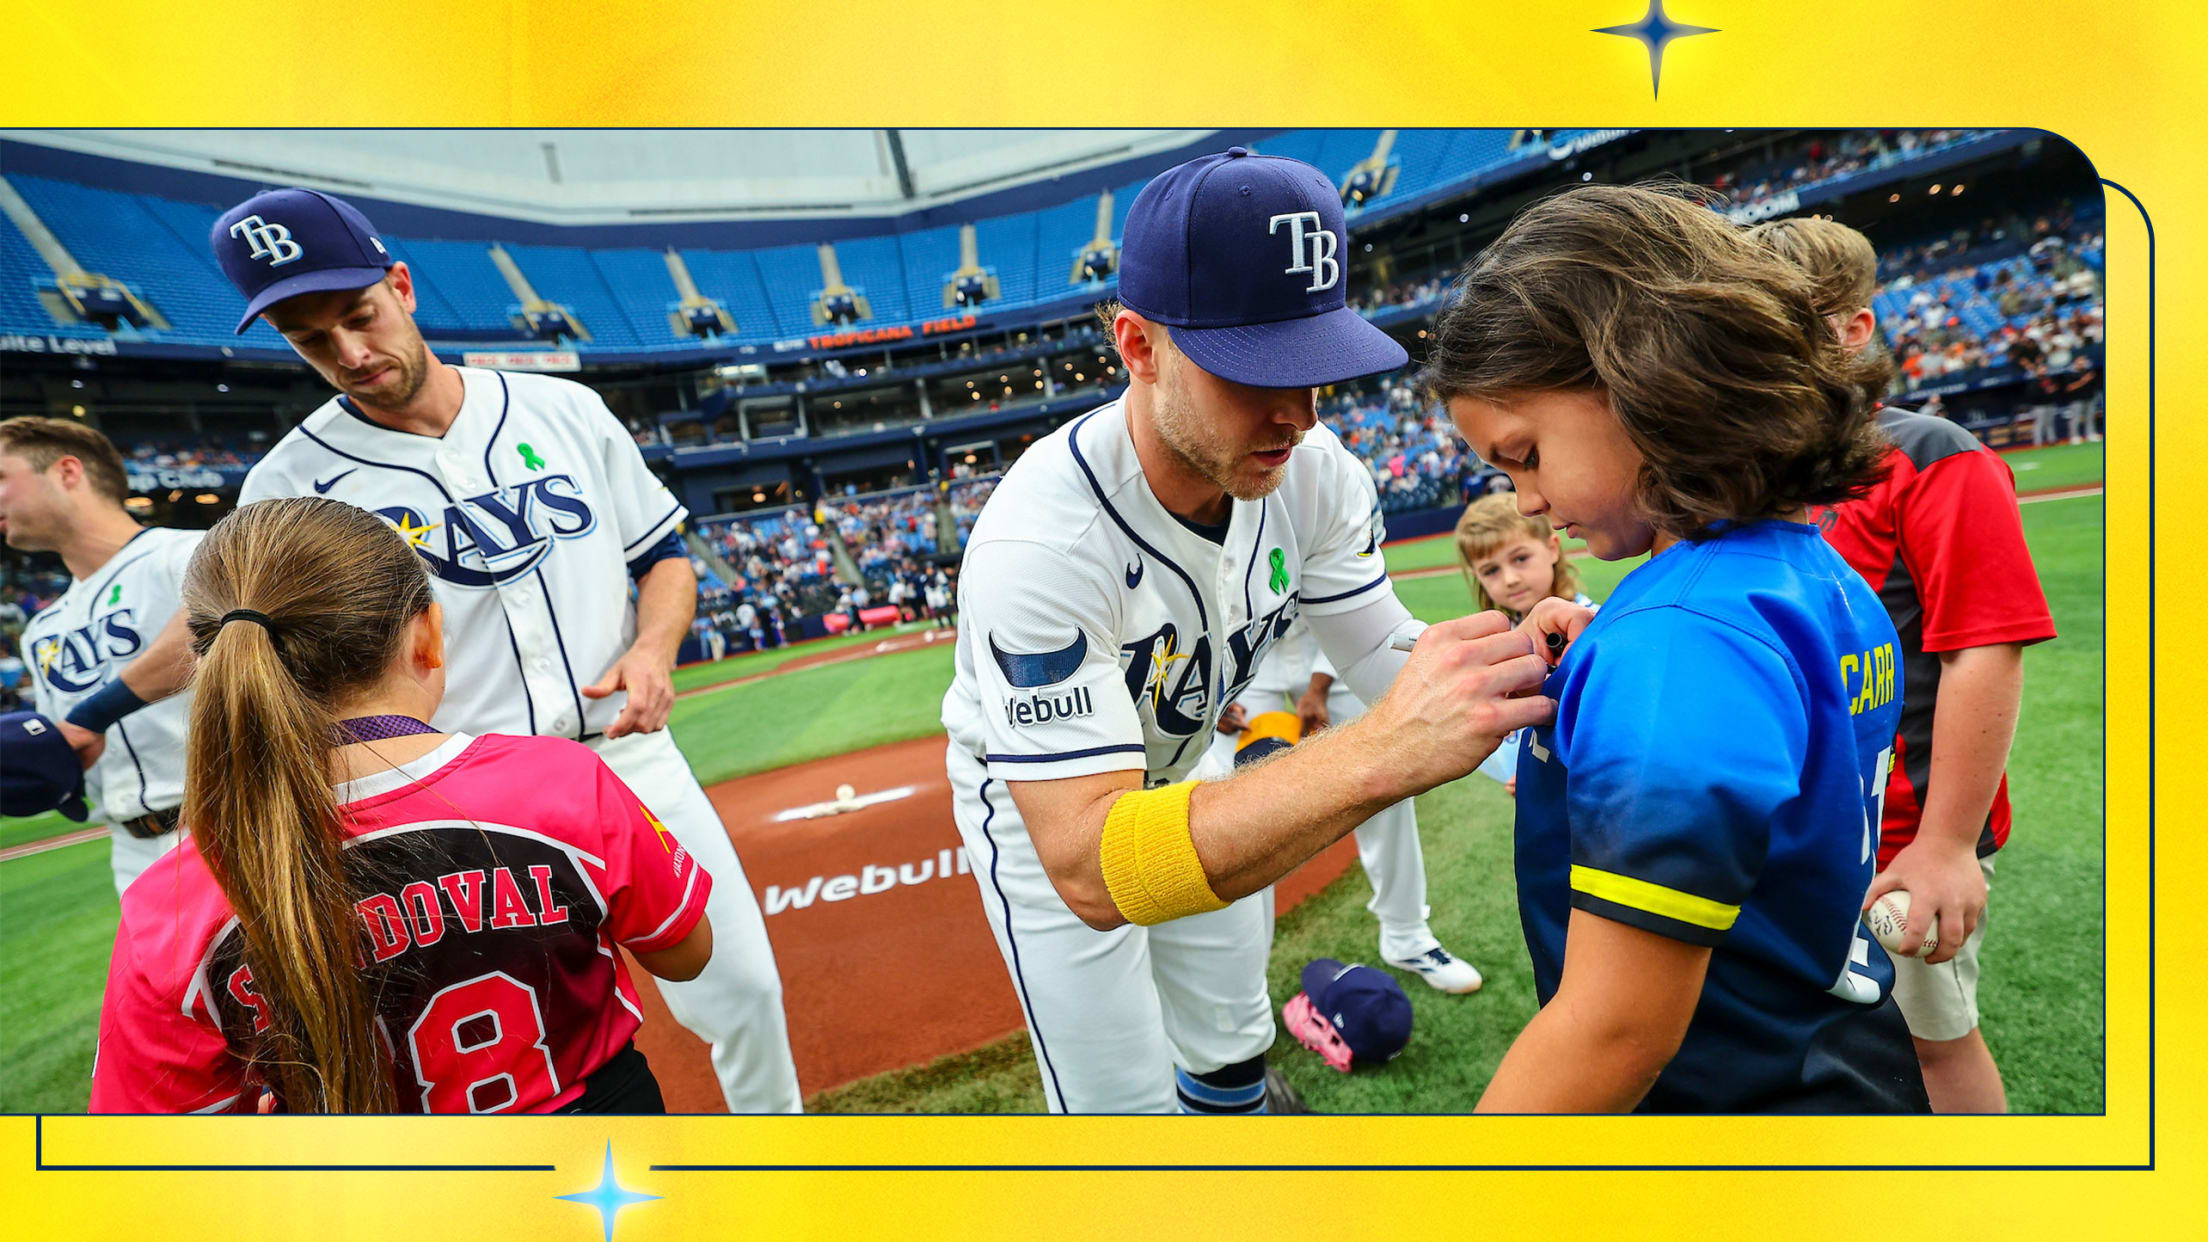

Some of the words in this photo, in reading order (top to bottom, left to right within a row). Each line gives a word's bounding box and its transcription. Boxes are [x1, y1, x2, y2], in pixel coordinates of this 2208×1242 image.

[229, 214, 303, 267] TB
[1269, 211, 1339, 294] TB
[48, 334, 118, 355] Level
[808, 326, 913, 349] TROPICANA
[922, 315, 976, 335] FIELD
[159, 467, 224, 489] Club
[31, 607, 146, 692] RAYS
[1840, 642, 1895, 716] CARR
[764, 846, 971, 916] Webull
[227, 864, 569, 1037] SDOVAL
